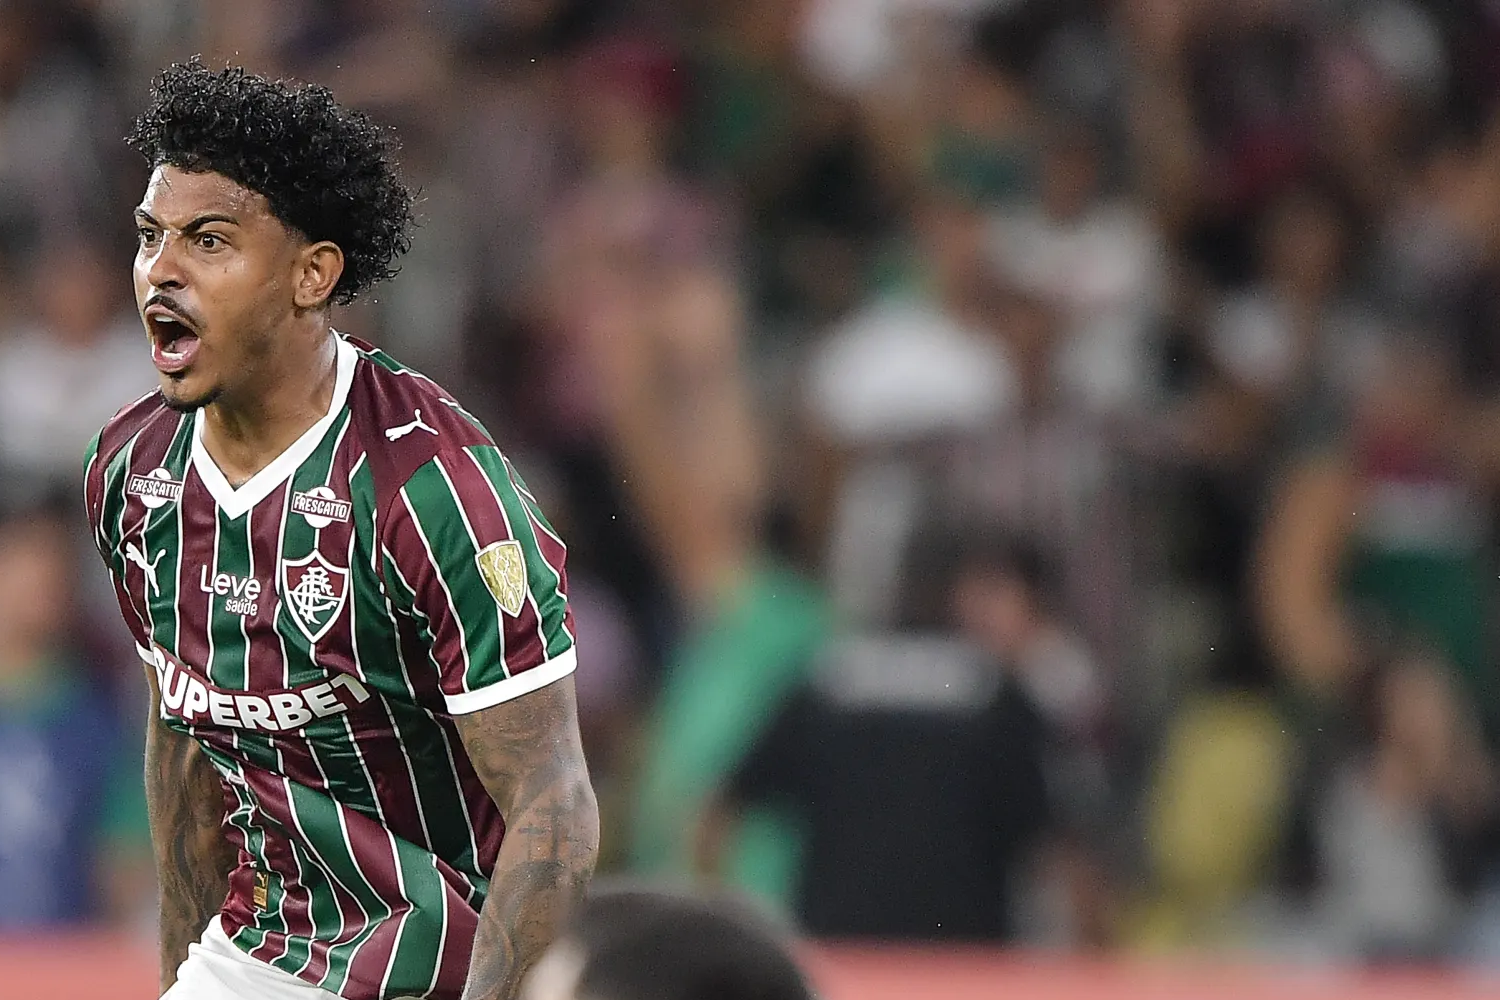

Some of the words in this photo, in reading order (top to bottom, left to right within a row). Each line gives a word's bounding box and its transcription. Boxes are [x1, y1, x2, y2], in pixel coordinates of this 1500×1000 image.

[293, 496, 347, 518] FRESCATTO
[200, 564, 261, 601] Leve
[225, 598, 258, 616] saúde
